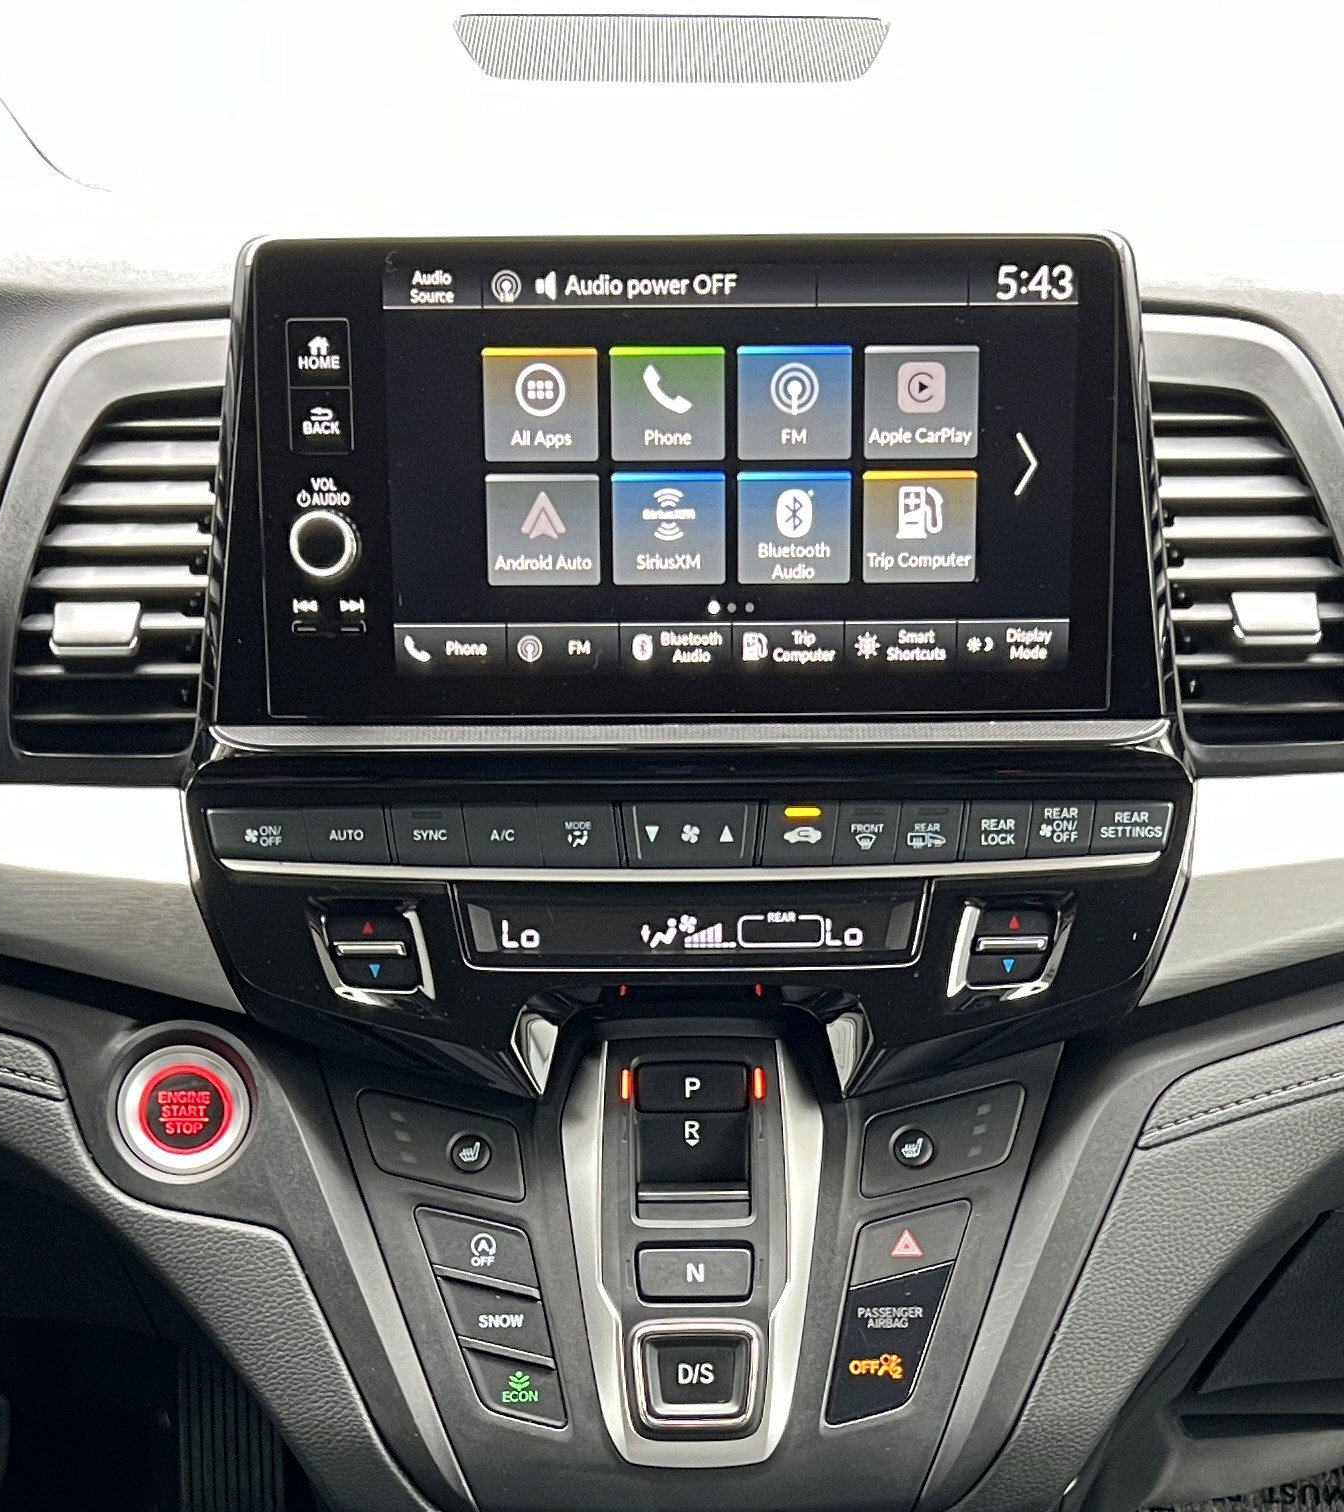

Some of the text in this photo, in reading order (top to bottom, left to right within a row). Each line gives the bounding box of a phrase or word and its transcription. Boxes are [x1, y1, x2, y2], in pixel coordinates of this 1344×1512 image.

[411, 269, 453, 287] Audio
[564, 273, 738, 299] Audio power OFF
[996, 264, 1074, 301] 5:43
[410, 287, 454, 304] Source
[298, 355, 341, 371] HOME
[302, 420, 341, 436] BACK
[511, 430, 573, 450] All Apps
[644, 429, 693, 446] Phone
[781, 429, 807, 445] FM
[868, 427, 974, 447] Apple CarPlay
[311, 477, 337, 493] VOL
[312, 492, 351, 507] AUDIO
[758, 543, 831, 560] Bluetooth
[494, 554, 594, 572] Android Auto
[636, 553, 701, 570] SiriusXM
[867, 552, 973, 570] Trip Computer
[771, 564, 816, 580] Audio
[660, 631, 723, 648] Bluetooth
[791, 629, 817, 647] Trip
[897, 629, 936, 645] Smart
[1005, 627, 1053, 646] Display
[445, 640, 488, 657] Phone
[567, 640, 592, 656] FM
[672, 648, 712, 664] Audio
[772, 647, 837, 664] Computer
[886, 645, 947, 662] Shortcuts
[1009, 645, 1048, 661] Mode
[1044, 807, 1079, 820] REAR
[1114, 810, 1149, 824] REAR
[564, 821, 592, 831] MODE
[850, 823, 884, 835] FRONT
[914, 823, 941, 834] REAR
[981, 818, 1016, 832] REAR
[1053, 820, 1078, 833] ON/
[1100, 824, 1163, 840] SETTINGS
[259, 836, 283, 848] OFF
[328, 829, 365, 842] AUTO
[412, 829, 448, 842] SYNC
[490, 828, 516, 843] A/C
[981, 831, 1016, 846] LOCK
[1053, 830, 1079, 843] OFF
[766, 911, 797, 924] REAR
[683, 1077, 701, 1098] P
[157, 1090, 212, 1105] ENGINE
[161, 1104, 208, 1118] START
[165, 1121, 204, 1135] STOP
[683, 1120, 700, 1140] R
[471, 1256, 496, 1267] OFF
[686, 1262, 705, 1283] N
[857, 1306, 924, 1319] PASSENGER
[478, 1314, 524, 1329] SNOW
[866, 1318, 910, 1329] AIRBAG
[676, 1363, 715, 1386] D/S
[848, 1359, 880, 1375] OFF
[502, 1390, 539, 1403] ECON
